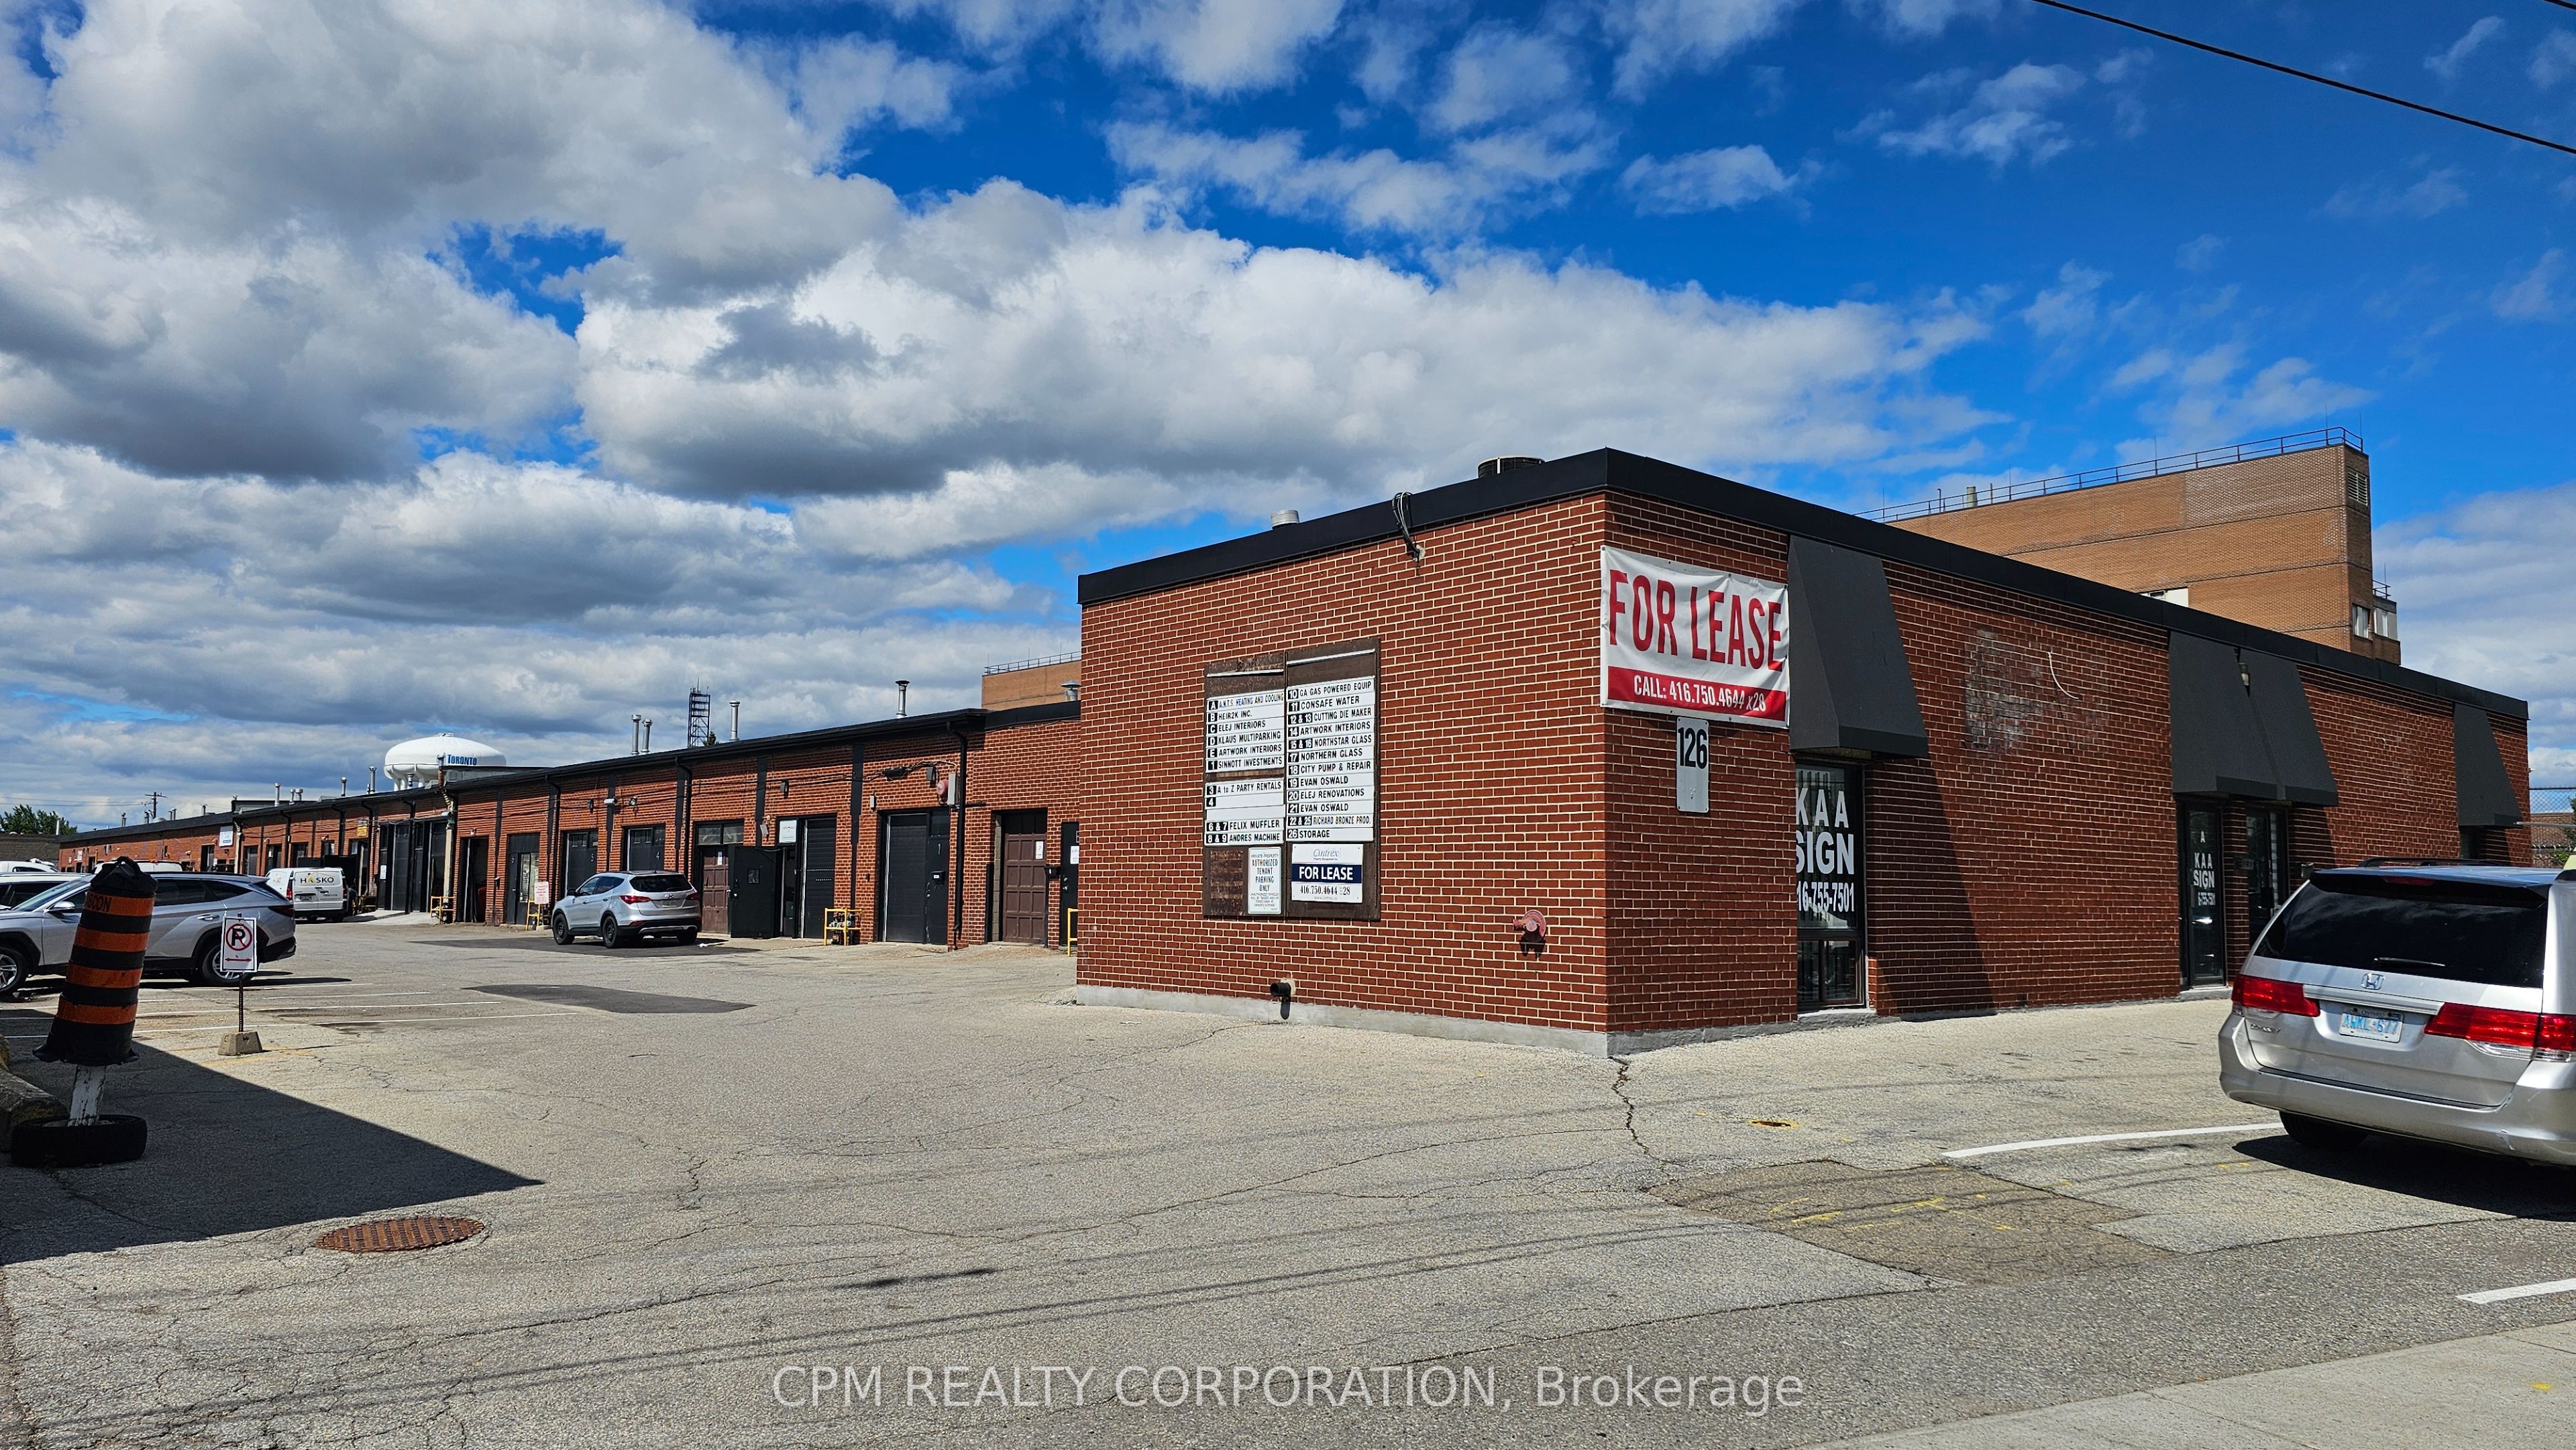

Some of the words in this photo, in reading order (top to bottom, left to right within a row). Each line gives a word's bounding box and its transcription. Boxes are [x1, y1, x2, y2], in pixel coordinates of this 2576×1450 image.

[1609, 568, 1678, 656] FOR
[1690, 586, 1783, 672] LEASE
[1289, 690, 1297, 698] 10
[1310, 687, 1321, 696] GAS
[1324, 684, 1351, 694] POWERED
[1354, 681, 1372, 690] EQUIP
[1633, 674, 1667, 699] CALL:
[1669, 680, 1745, 709] 416.750.4644
[1746, 692, 1766, 712] x28
[1211, 701, 1216, 710] A
[1236, 698, 1253, 706] HEATING
[1254, 696, 1263, 704] AND
[1265, 693, 1283, 703] COOLING
[1291, 703, 1298, 711] 11
[1301, 698, 1333, 710] CONSAFE
[1336, 696, 1360, 706] WATER
[1210, 713, 1216, 721] B
[1219, 711, 1238, 720] HEIR2K
[1290, 715, 1297, 724] 12
[1298, 714, 1303, 723] &
[1305, 713, 1311, 722] 13
[1314, 711, 1337, 721] CUTTING
[1340, 710, 1348, 719] DIE
[1351, 707, 1371, 717] MAKER
[1218, 724, 1232, 732] ELEJ
[1234, 720, 1266, 730] INTERIORS
[1289, 727, 1298, 736] 14
[1300, 725, 1332, 735] ARTWORK
[1335, 721, 1371, 731] INTERIORS
[1210, 737, 1215, 745] D
[1218, 735, 1236, 744] KLAUS
[1239, 731, 1281, 742] MULTIPARKING
[1290, 740, 1297, 749] 15
[1298, 739, 1303, 748] &
[1305, 739, 1311, 747] 16
[1314, 736, 1349, 747] NORTHSTAR
[1351, 735, 1372, 744] GLASS
[1210, 749, 1215, 758] E
[1219, 747, 1248, 756] ARTWORK
[1250, 744, 1282, 754] INTERIORS
[1289, 754, 1297, 762] 17
[1301, 750, 1337, 761] NORTHERN
[1340, 748, 1362, 758] GLASS
[1678, 727, 1707, 770] 126
[447, 754, 477, 766] TORONTO
[1218, 760, 1241, 768] SINNOTT
[1244, 757, 1282, 767] INVESTMENTS
[1289, 766, 1298, 774] 18
[1301, 765, 1315, 774] CITY
[1318, 764, 1336, 772] PUMP
[1339, 763, 1343, 771] &
[1346, 761, 1371, 770] REPAIR
[1209, 786, 1214, 794] 3
[1236, 784, 1254, 792] PARTY
[1256, 782, 1281, 790] RENTALS
[1289, 778, 1297, 787] 19
[1301, 778, 1318, 786] EVAN
[1320, 776, 1348, 785] OSWALD
[1288, 792, 1298, 800] 20
[1301, 791, 1316, 799] ELEJ
[1318, 788, 1364, 798] RENOVATIONS
[1208, 798, 1214, 806] 4
[1289, 805, 1298, 813] 21
[1320, 803, 1349, 811] OSWALD
[1796, 787, 1849, 829] KAA
[1208, 823, 1214, 831] 6
[1223, 822, 1228, 830] 7
[1230, 821, 1247, 829] FELIX
[1250, 820, 1280, 829] MUFFLER
[1289, 817, 1297, 825] 22
[1304, 817, 1311, 825] 25
[1313, 817, 1334, 825] RICHARD
[1336, 816, 1354, 824] BRONZE
[1356, 816, 1371, 824] PROD.
[1208, 835, 1213, 843] 8
[1229, 833, 1252, 841] ANDRES
[1254, 833, 1280, 841] MACHINE
[1288, 829, 1297, 838] 26
[1299, 830, 1330, 838] STORAGE
[2200, 831, 2206, 843] A
[1796, 829, 1854, 875] SIGN
[1252, 859, 1278, 867] AUTHORIZED
[2194, 852, 2213, 869] KAA
[1299, 866, 1319, 880] FOR
[1321, 867, 1353, 880] LEASE
[2193, 870, 2214, 888] SIGN
[1300, 885, 1338, 895] 416.750.4644
[1343, 886, 1350, 896] 28
[1796, 881, 1854, 913] 16-755-7501
